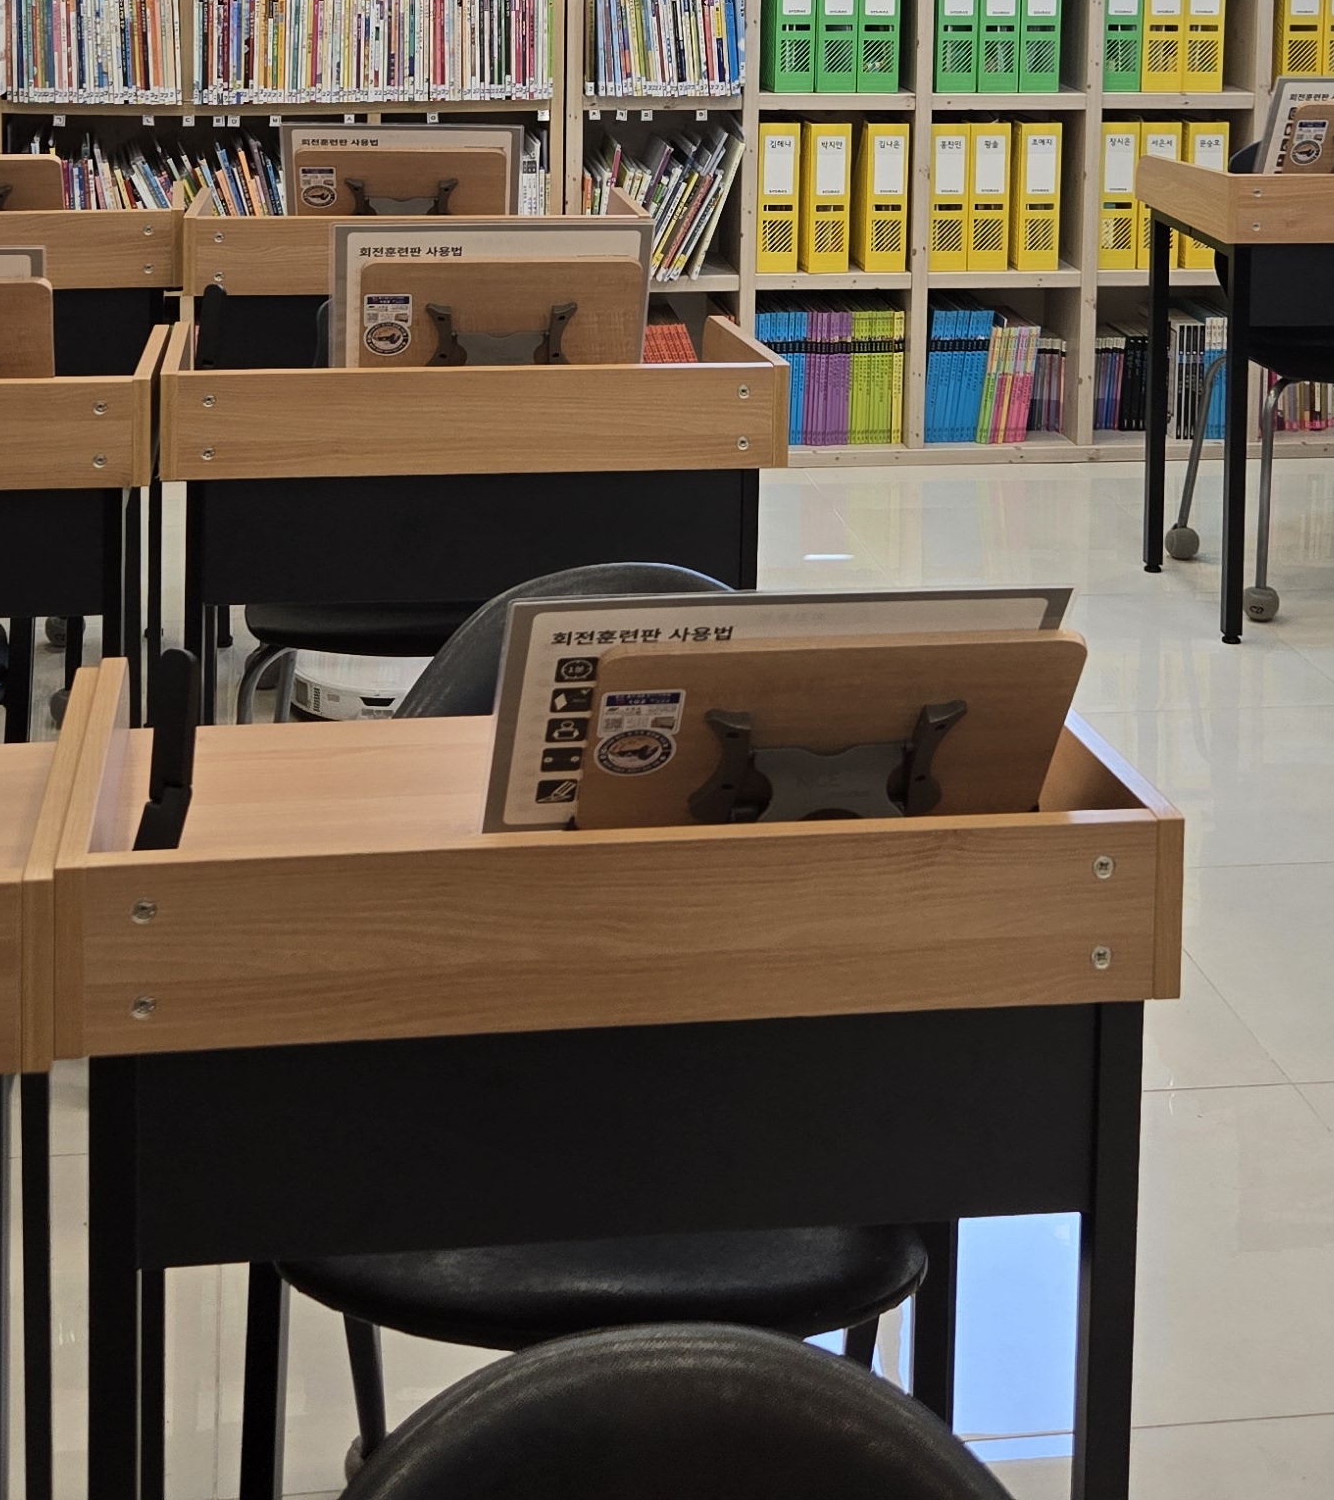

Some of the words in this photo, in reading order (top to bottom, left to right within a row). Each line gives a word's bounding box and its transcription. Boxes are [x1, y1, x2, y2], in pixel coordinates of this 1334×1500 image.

[359, 247, 422, 258] 회전훈련판
[426, 246, 463, 257] 사용법
[551, 628, 661, 646] 회전훈련판
[669, 625, 734, 643] 사용법
